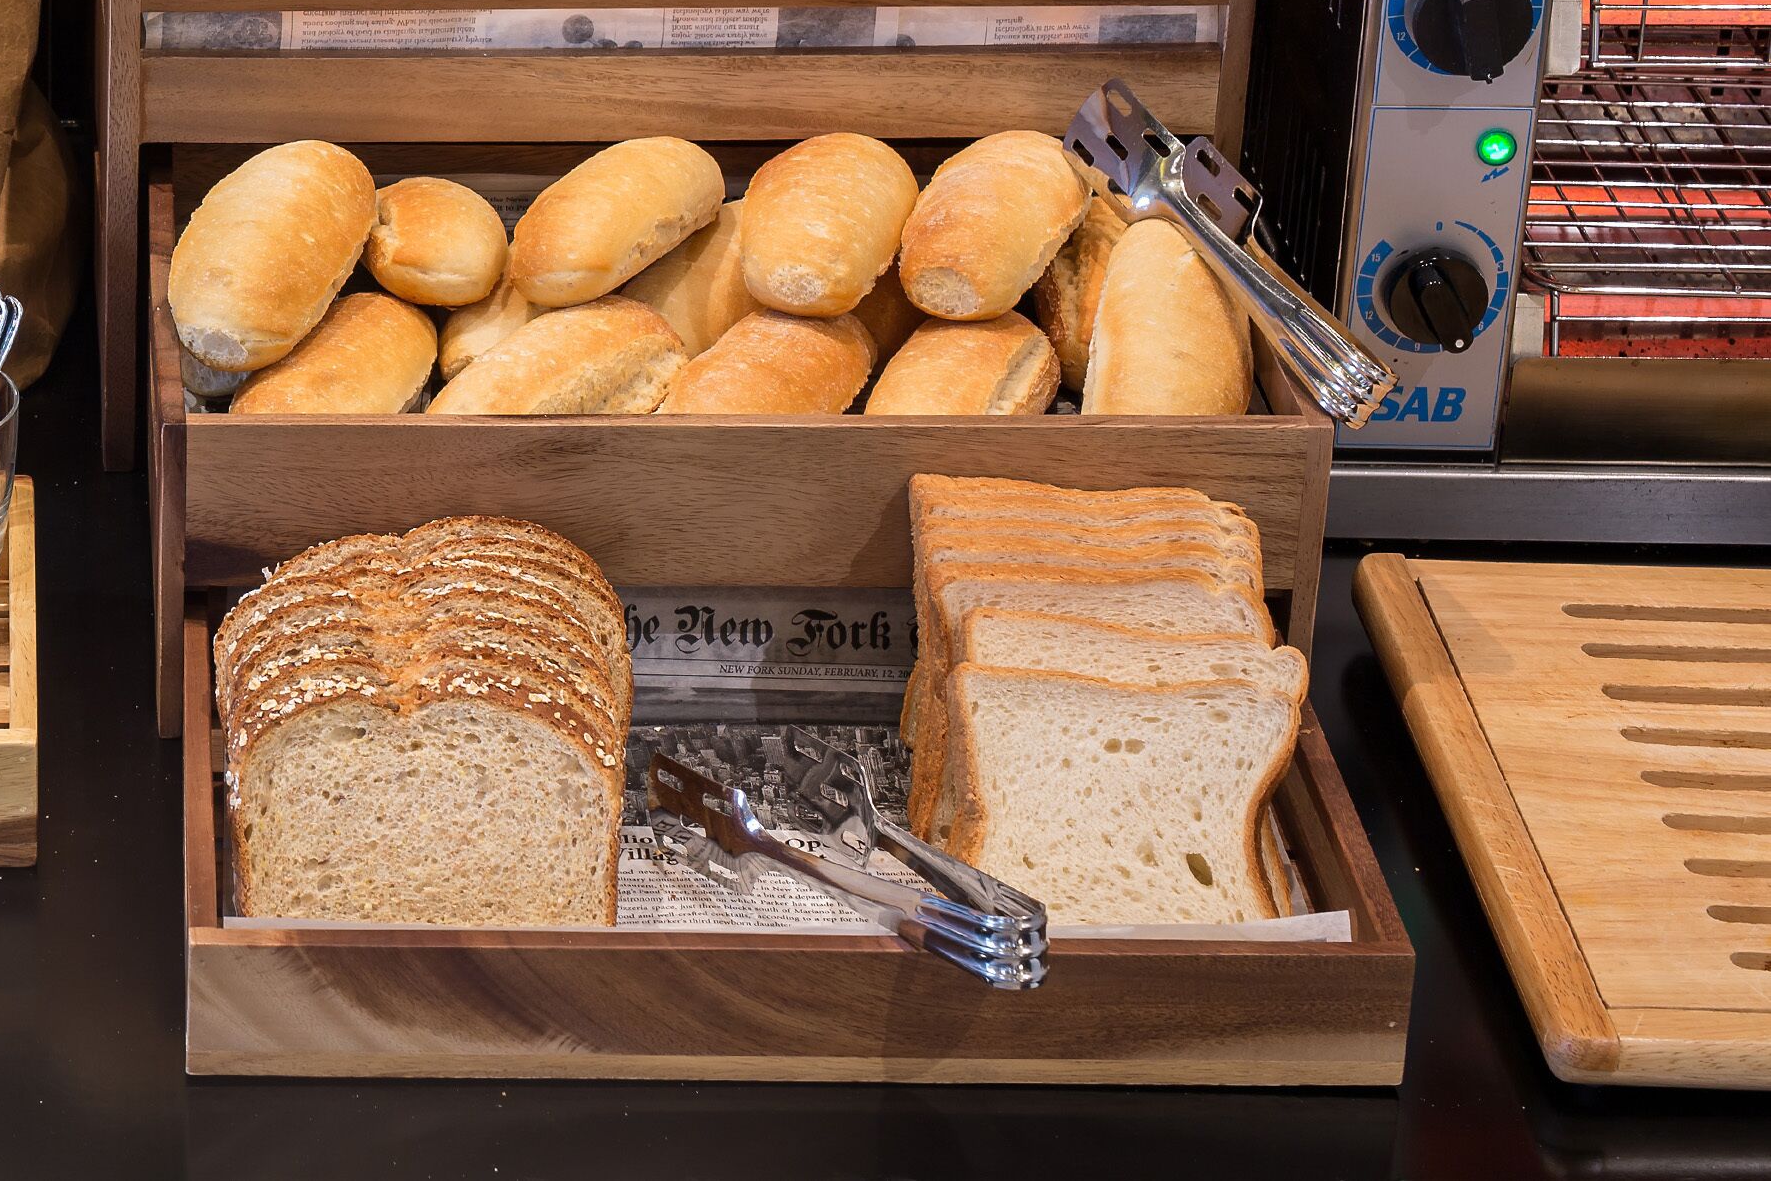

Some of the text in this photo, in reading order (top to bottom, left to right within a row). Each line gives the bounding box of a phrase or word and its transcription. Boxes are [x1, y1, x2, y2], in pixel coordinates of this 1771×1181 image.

[1396, 32, 1406, 41] 12
[1371, 253, 1381, 262] 15
[1497, 262, 1504, 271] 3
[1364, 310, 1374, 320] 12
[1478, 321, 1484, 330] 6
[1414, 343, 1421, 351] 9
[624, 603, 660, 652] he
[674, 605, 774, 654] New
[719, 665, 912, 679] NEW FORK SUNDAY, FEBRUARY, 12, 20
[619, 847, 680, 866] illag
